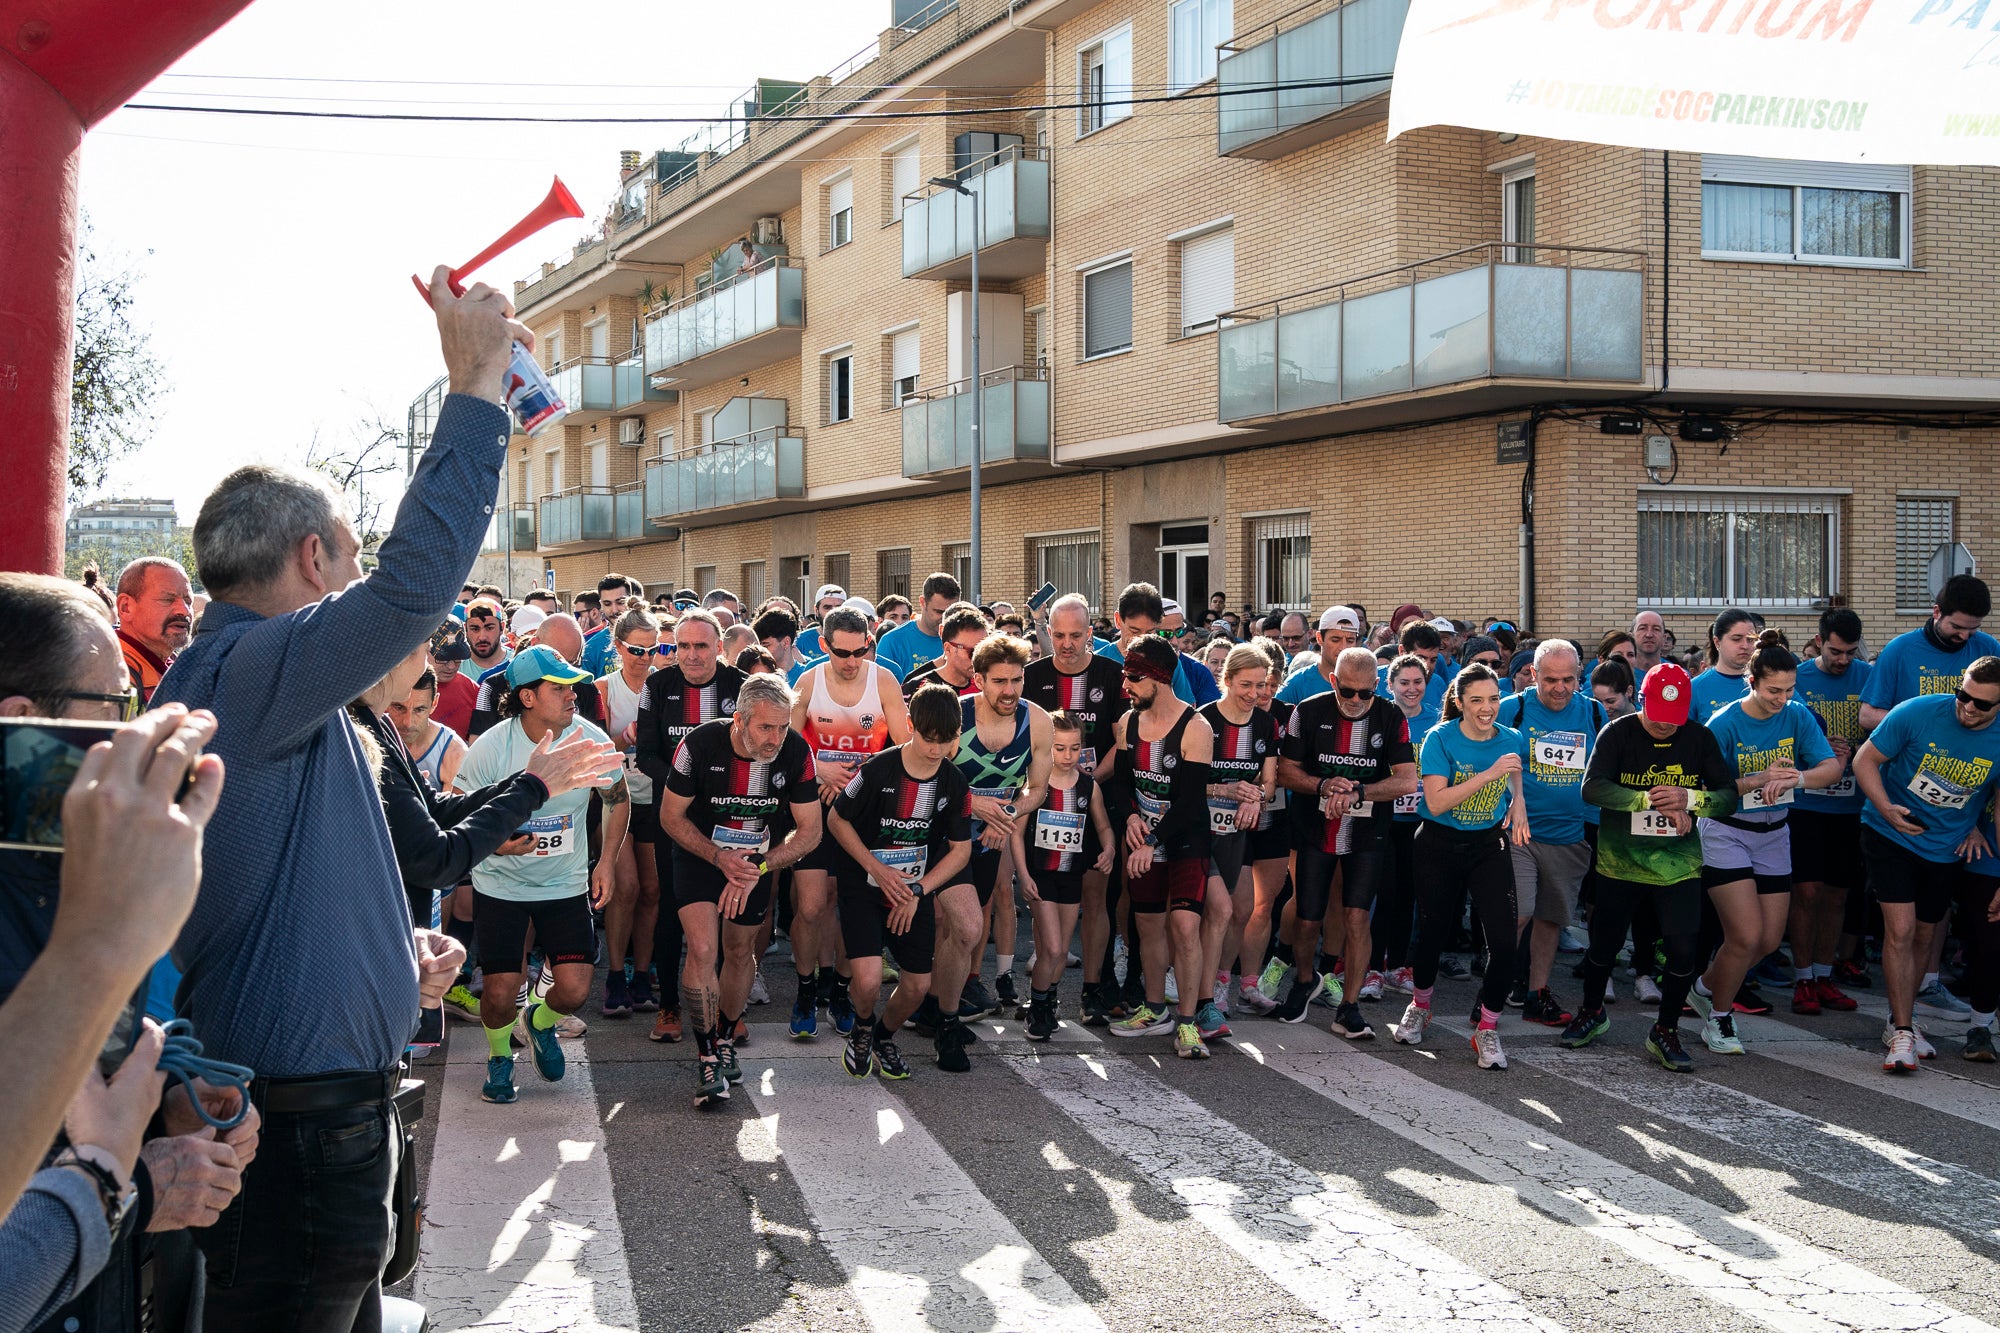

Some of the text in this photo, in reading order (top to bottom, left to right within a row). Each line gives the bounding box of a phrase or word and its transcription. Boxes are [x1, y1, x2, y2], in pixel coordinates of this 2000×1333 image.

[1501, 440, 1526, 449] VOLUNTARIS
[818, 733, 874, 749] UAT
[1318, 753, 1377, 767] AUTOESCOLA
[1544, 747, 1575, 761] 647
[1653, 774, 1678, 787] DRAC
[1678, 774, 1699, 786] RACE
[1919, 780, 1964, 803] 1210
[711, 796, 779, 806] AUTOESCOLA
[713, 804, 778, 816] STILO
[527, 819, 562, 827] ARKINSON
[1041, 828, 1081, 844] 1133
